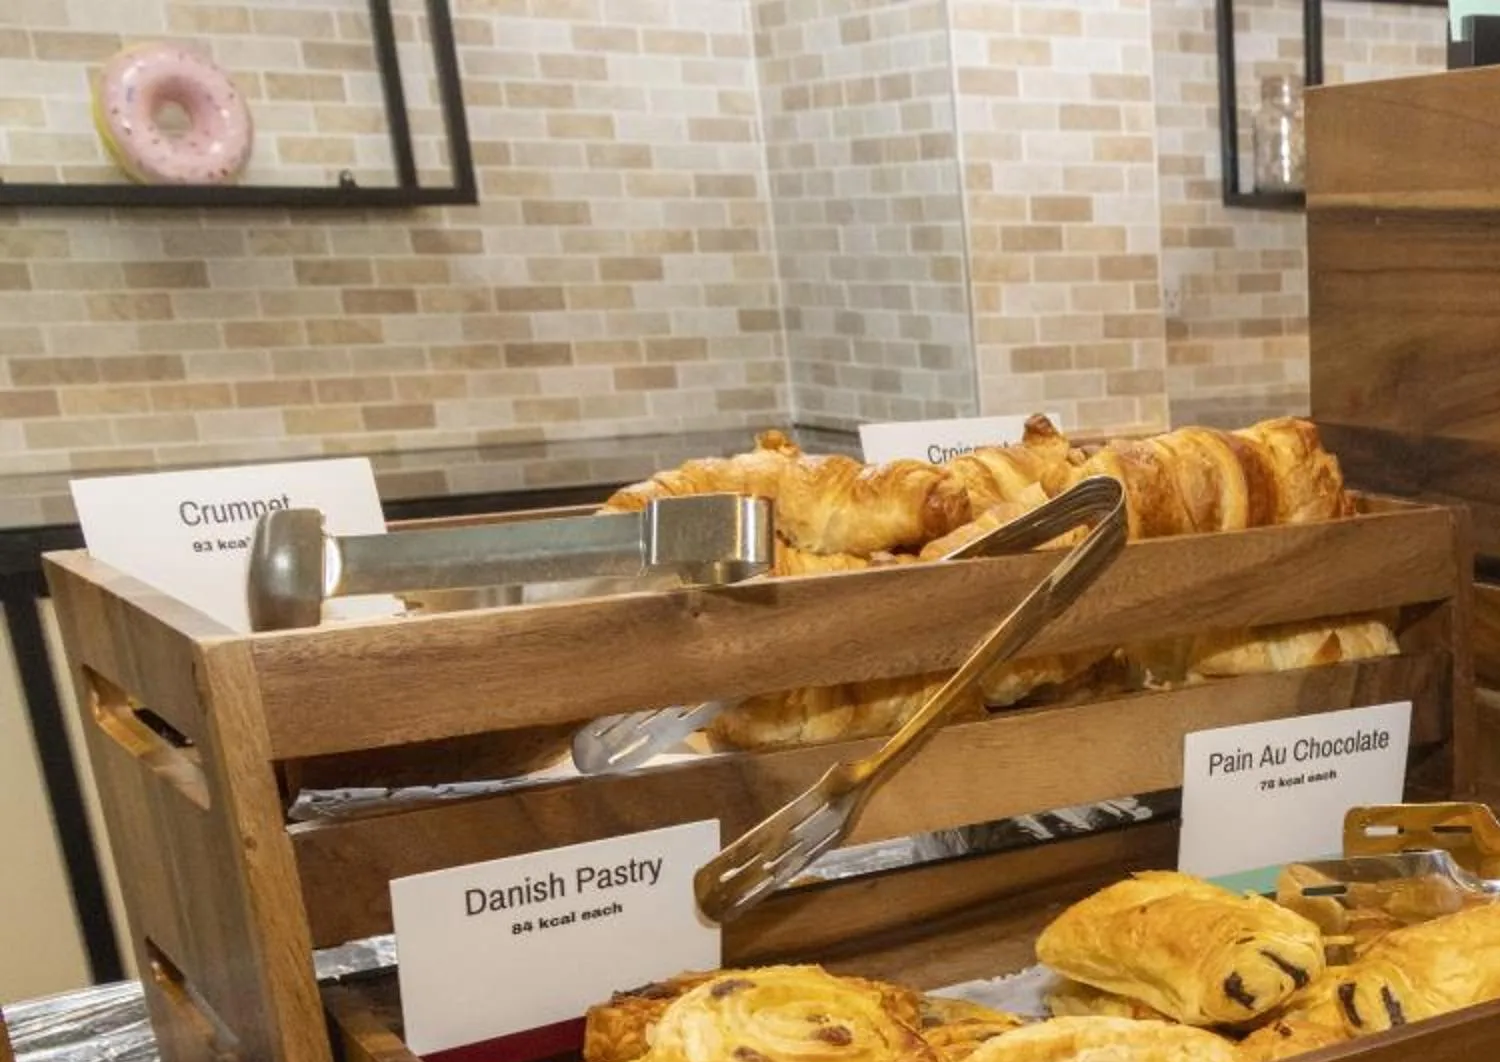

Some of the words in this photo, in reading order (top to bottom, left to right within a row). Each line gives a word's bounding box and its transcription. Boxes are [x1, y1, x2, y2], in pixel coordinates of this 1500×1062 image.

[193, 540, 213, 552] 93
[1209, 749, 1253, 776] Pain
[1259, 744, 1287, 768] Au
[1293, 729, 1390, 761] Chocolate
[1279, 773, 1305, 788] kcal
[1307, 769, 1337, 783] each
[464, 872, 566, 917] Danish
[576, 857, 663, 894] Pastry
[511, 921, 533, 935] 84
[538, 911, 576, 930] kcal
[581, 902, 623, 921] each
